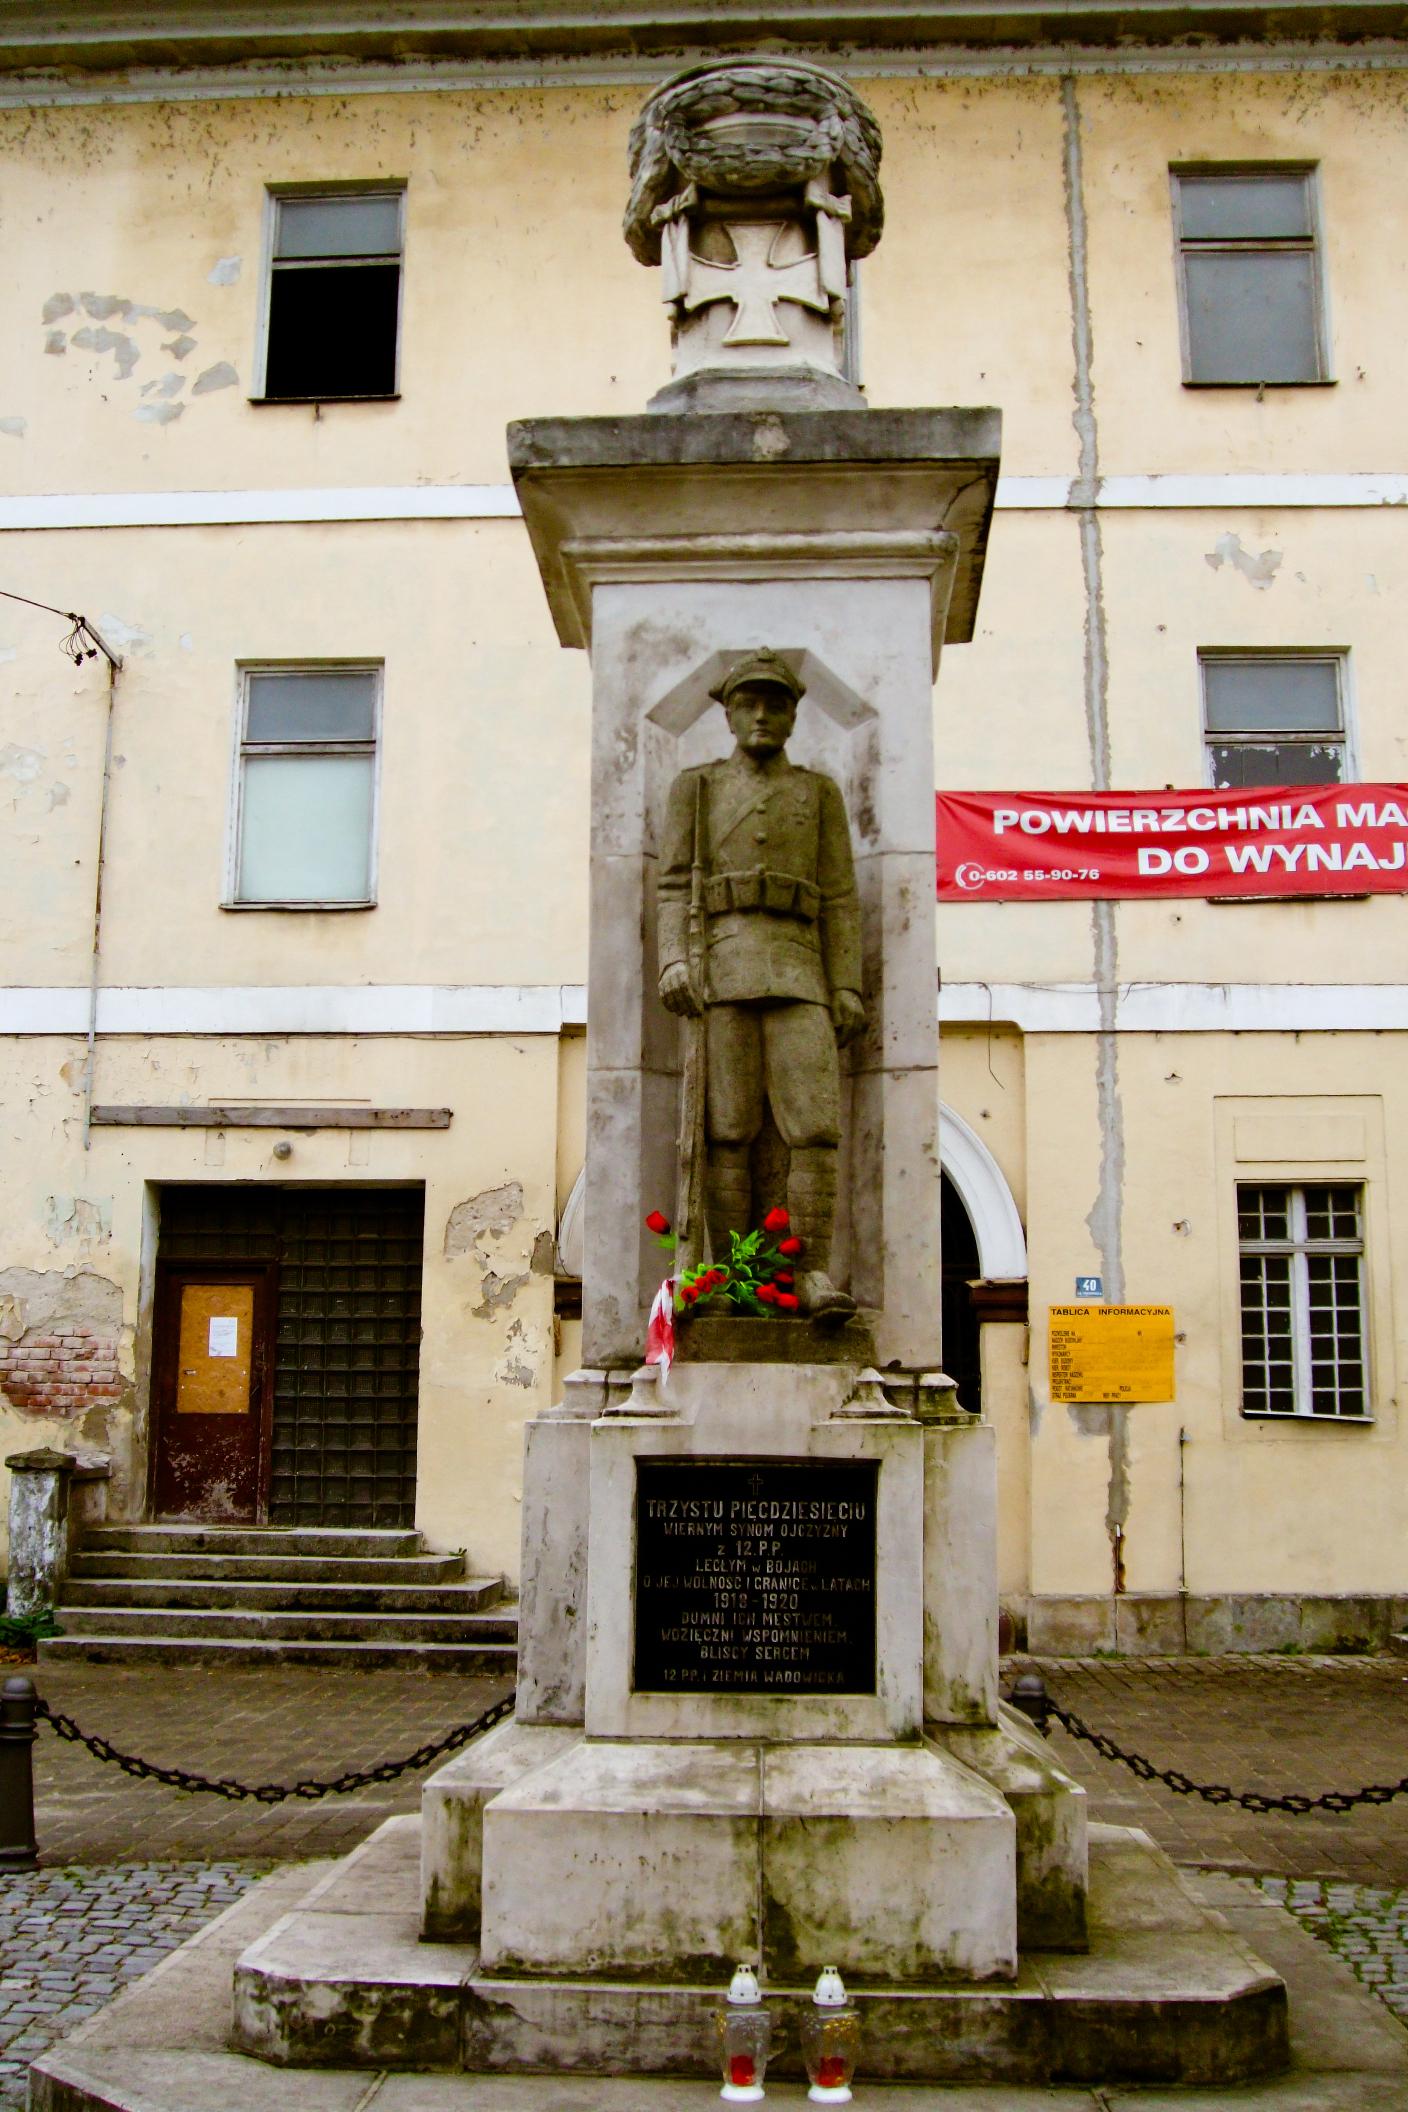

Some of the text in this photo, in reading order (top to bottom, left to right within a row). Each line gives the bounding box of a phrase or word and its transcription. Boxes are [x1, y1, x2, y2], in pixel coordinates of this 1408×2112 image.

[993, 803, 1408, 834] POWIERZCHNIA MA
[1137, 842, 1408, 876] DO WYNAJ
[969, 869, 1100, 881] 0-602 55-90-76
[1083, 1280, 1096, 1291] 40
[648, 1500, 723, 1518] TRZYSTU
[664, 1522, 848, 1538] WIERNYM SYNOM OJCZYZNY
[766, 1560, 817, 1573] BOJACH
[682, 1612, 725, 1625] DUMNI
[700, 1647, 810, 1660] BLISCY SERCEM
[712, 1670, 758, 1682] ZIEMIA
[764, 1671, 844, 1683] WADOWICKA
